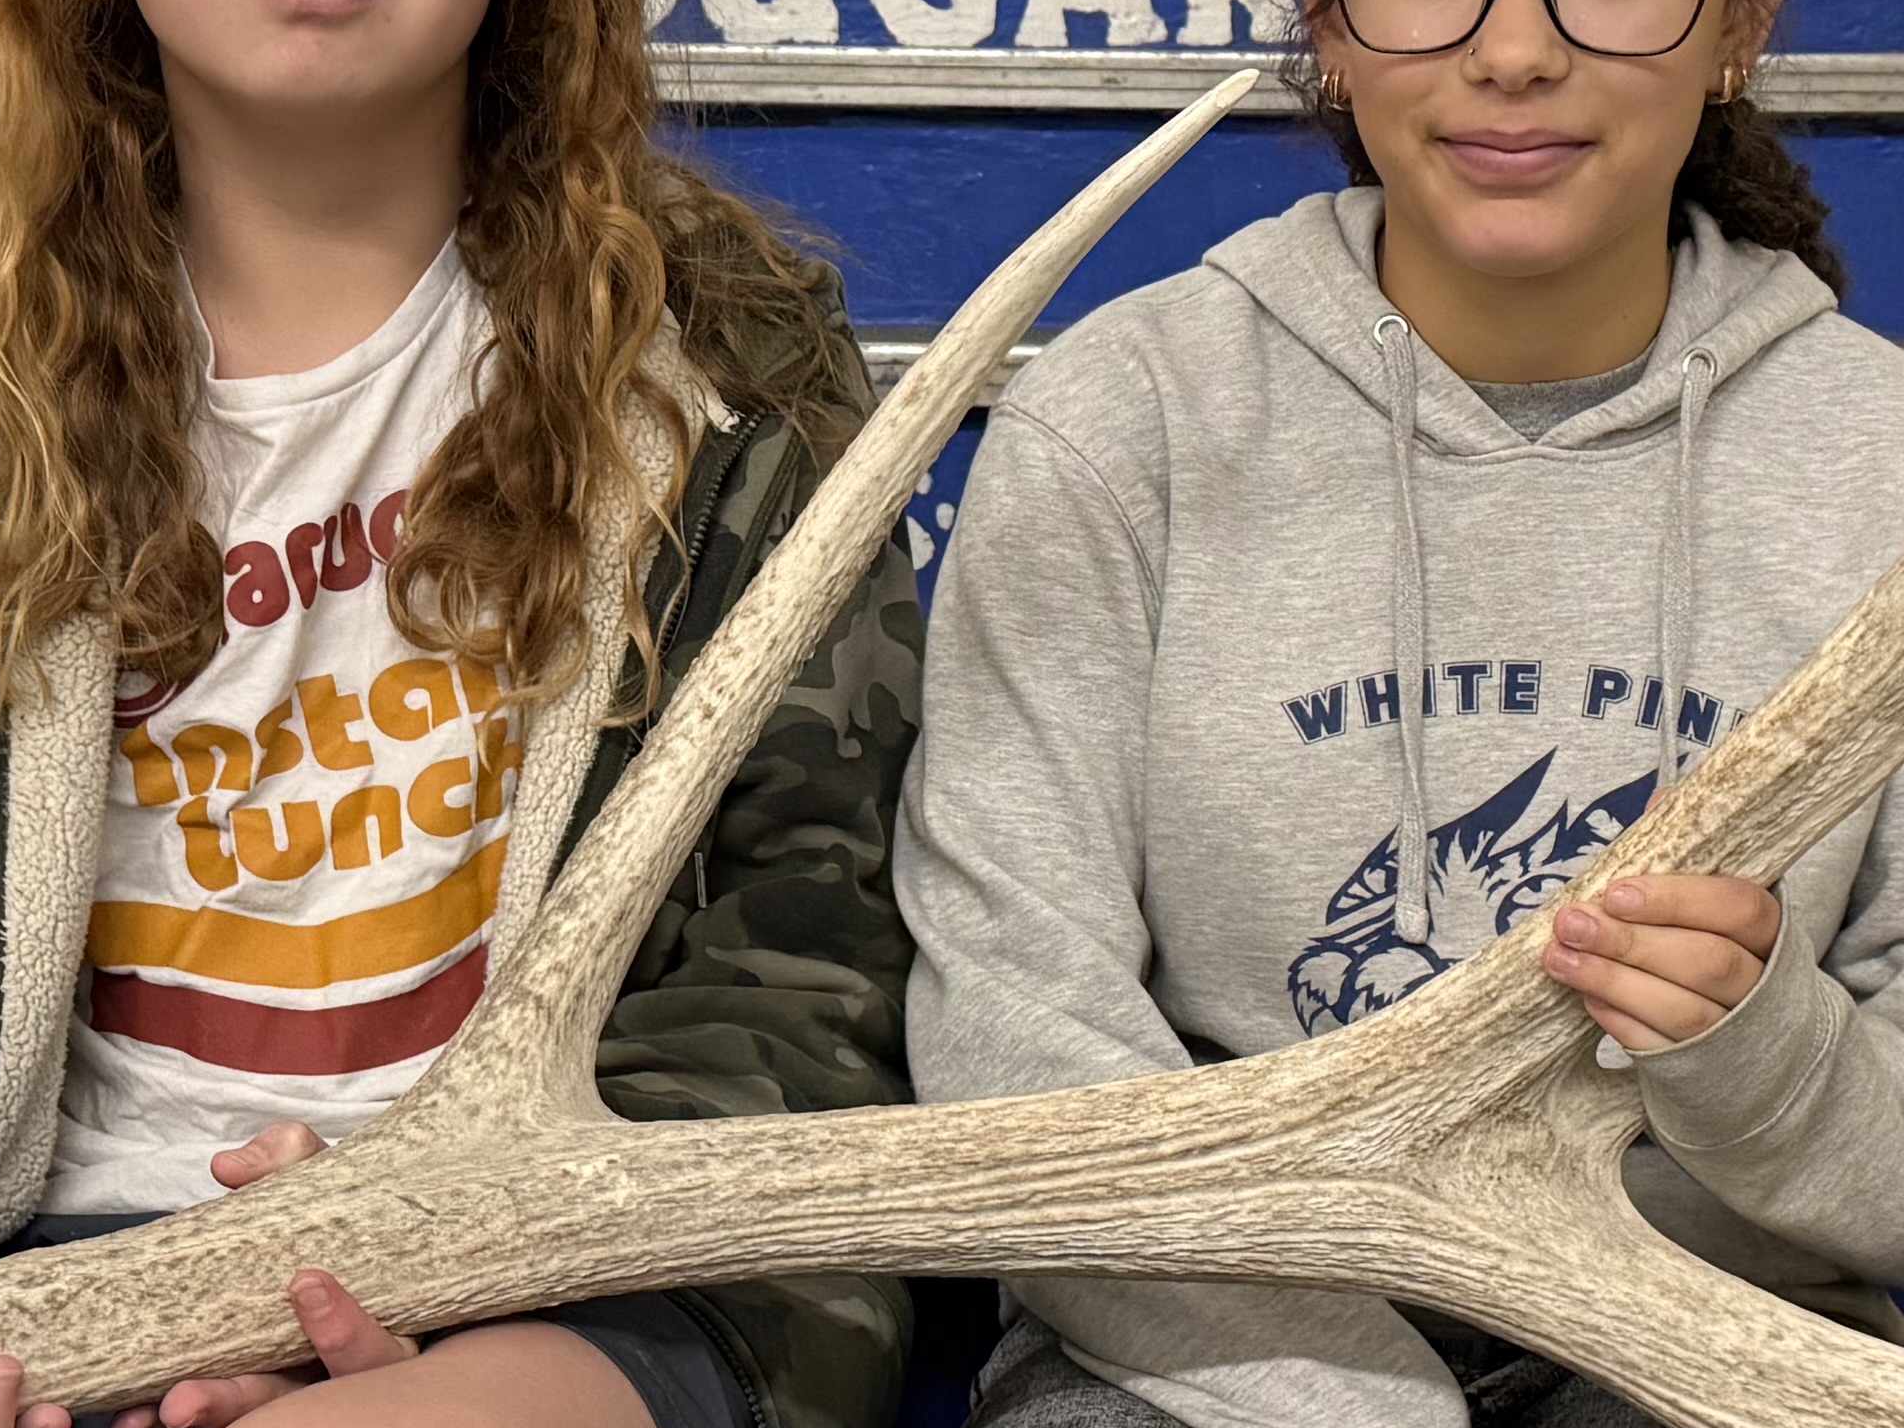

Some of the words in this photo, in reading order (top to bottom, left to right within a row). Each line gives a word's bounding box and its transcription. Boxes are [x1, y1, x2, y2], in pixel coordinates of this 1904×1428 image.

[119, 650, 504, 807] Insta
[1280, 659, 1542, 745] WHITE
[1581, 664, 1748, 748] PIN
